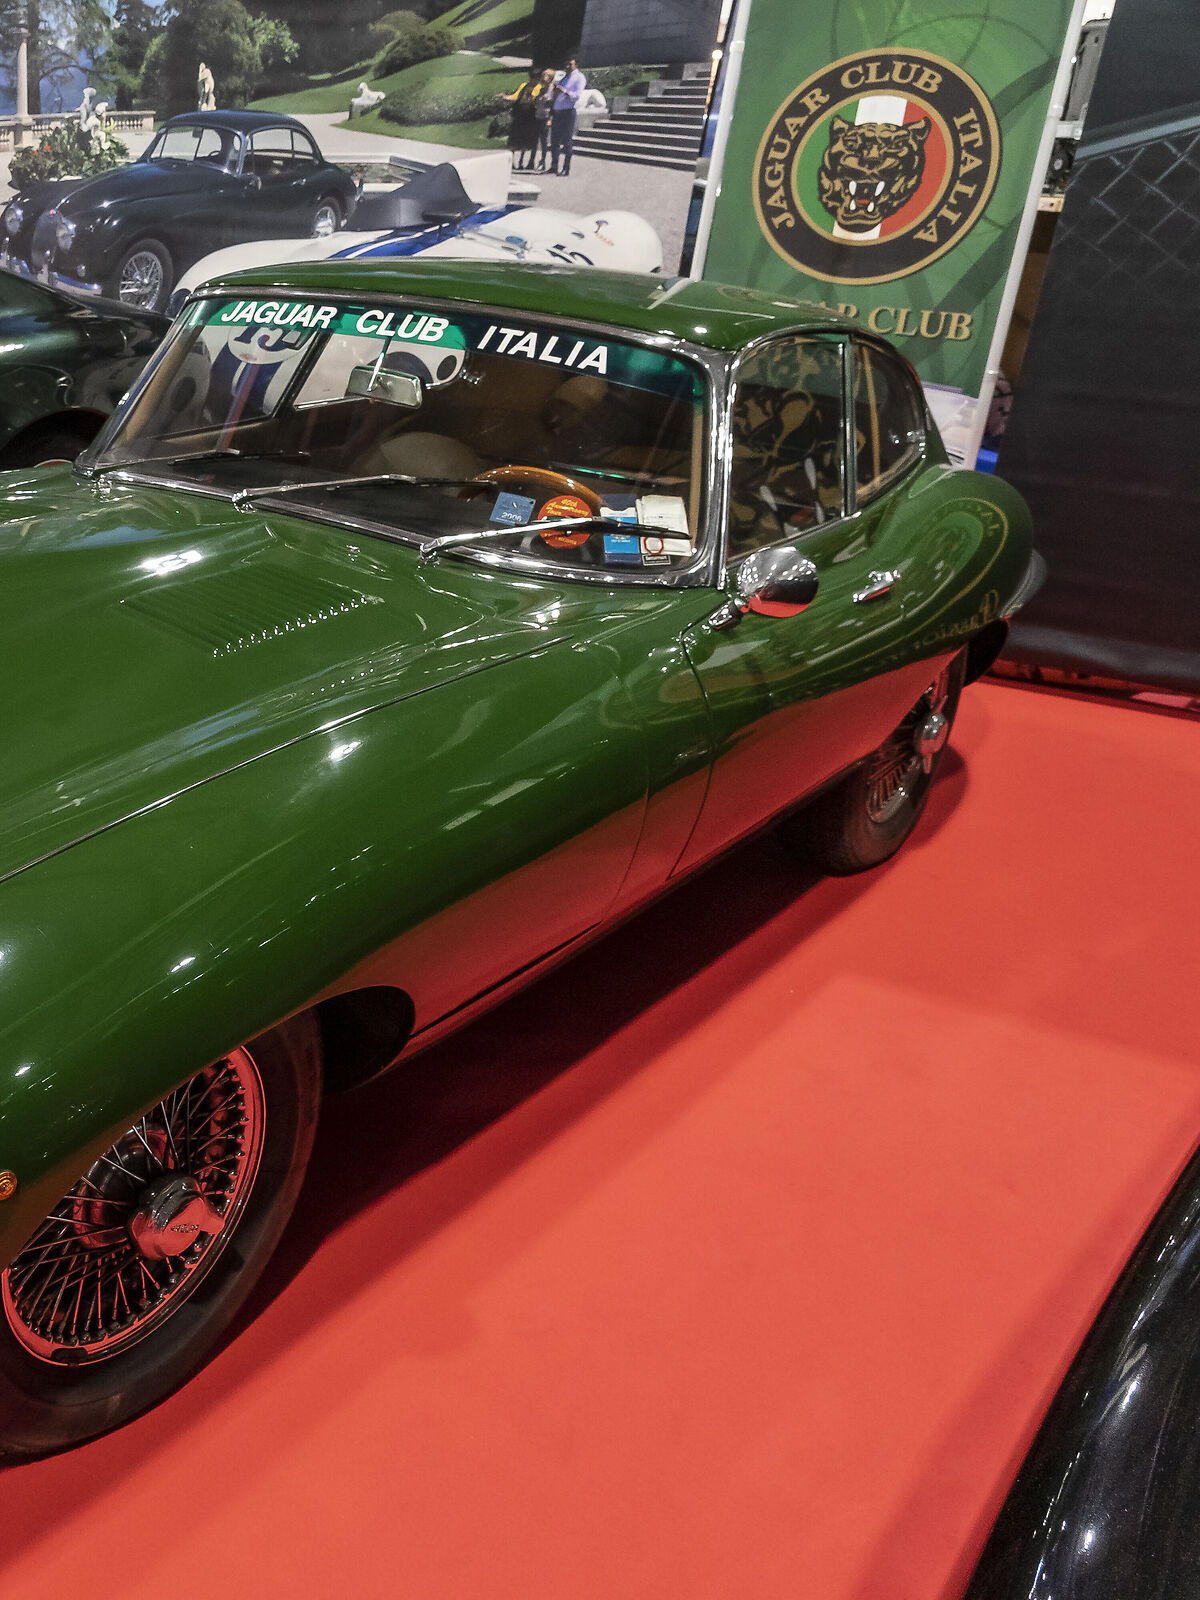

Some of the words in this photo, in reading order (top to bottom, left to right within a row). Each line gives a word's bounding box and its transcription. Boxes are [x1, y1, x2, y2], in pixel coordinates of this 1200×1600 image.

[764, 87, 832, 230] JAGUAR
[840, 60, 943, 95] CLUB
[913, 107, 984, 243] ITALIA
[221, 300, 338, 329] JAGUAR
[356, 309, 450, 342] CLUB
[476, 325, 609, 375] ITALIA
[868, 305, 973, 341] CLUB
